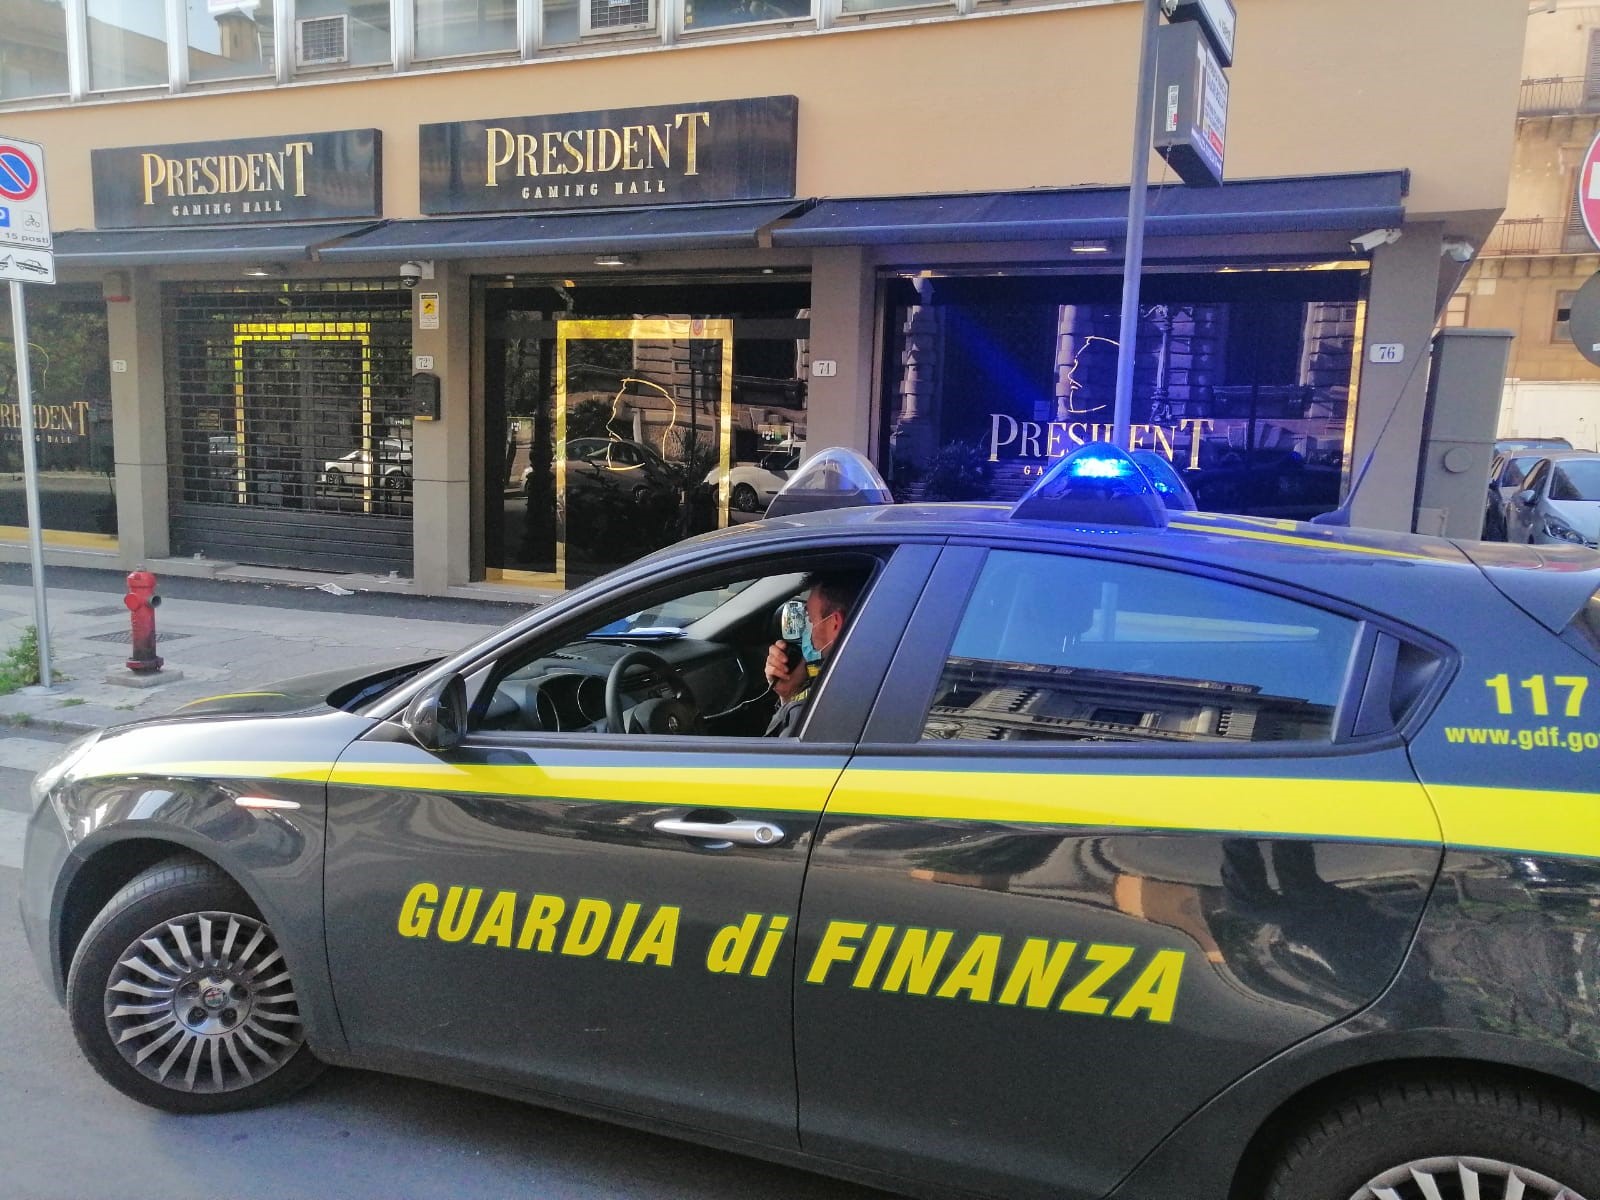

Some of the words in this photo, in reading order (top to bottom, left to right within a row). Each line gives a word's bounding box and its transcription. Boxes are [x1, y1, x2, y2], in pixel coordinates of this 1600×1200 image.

[485, 111, 710, 187] PRESIDENT
[141, 141, 313, 205] PRESIDENT
[522, 183, 598, 200] GAMING
[615, 179, 666, 195] HALL
[172, 203, 232, 216] GAMING
[243, 200, 283, 213] HALL
[5, 232, 18, 240] 15
[1379, 346, 1396, 360] 76
[0, 401, 89, 436] REIDENT
[1485, 673, 1589, 717] 117
[1444, 726, 1600, 752] www.gdf.go
[397, 881, 681, 968] GUARDIA
[706, 912, 789, 978] di
[806, 920, 1187, 1023] FINANZA
